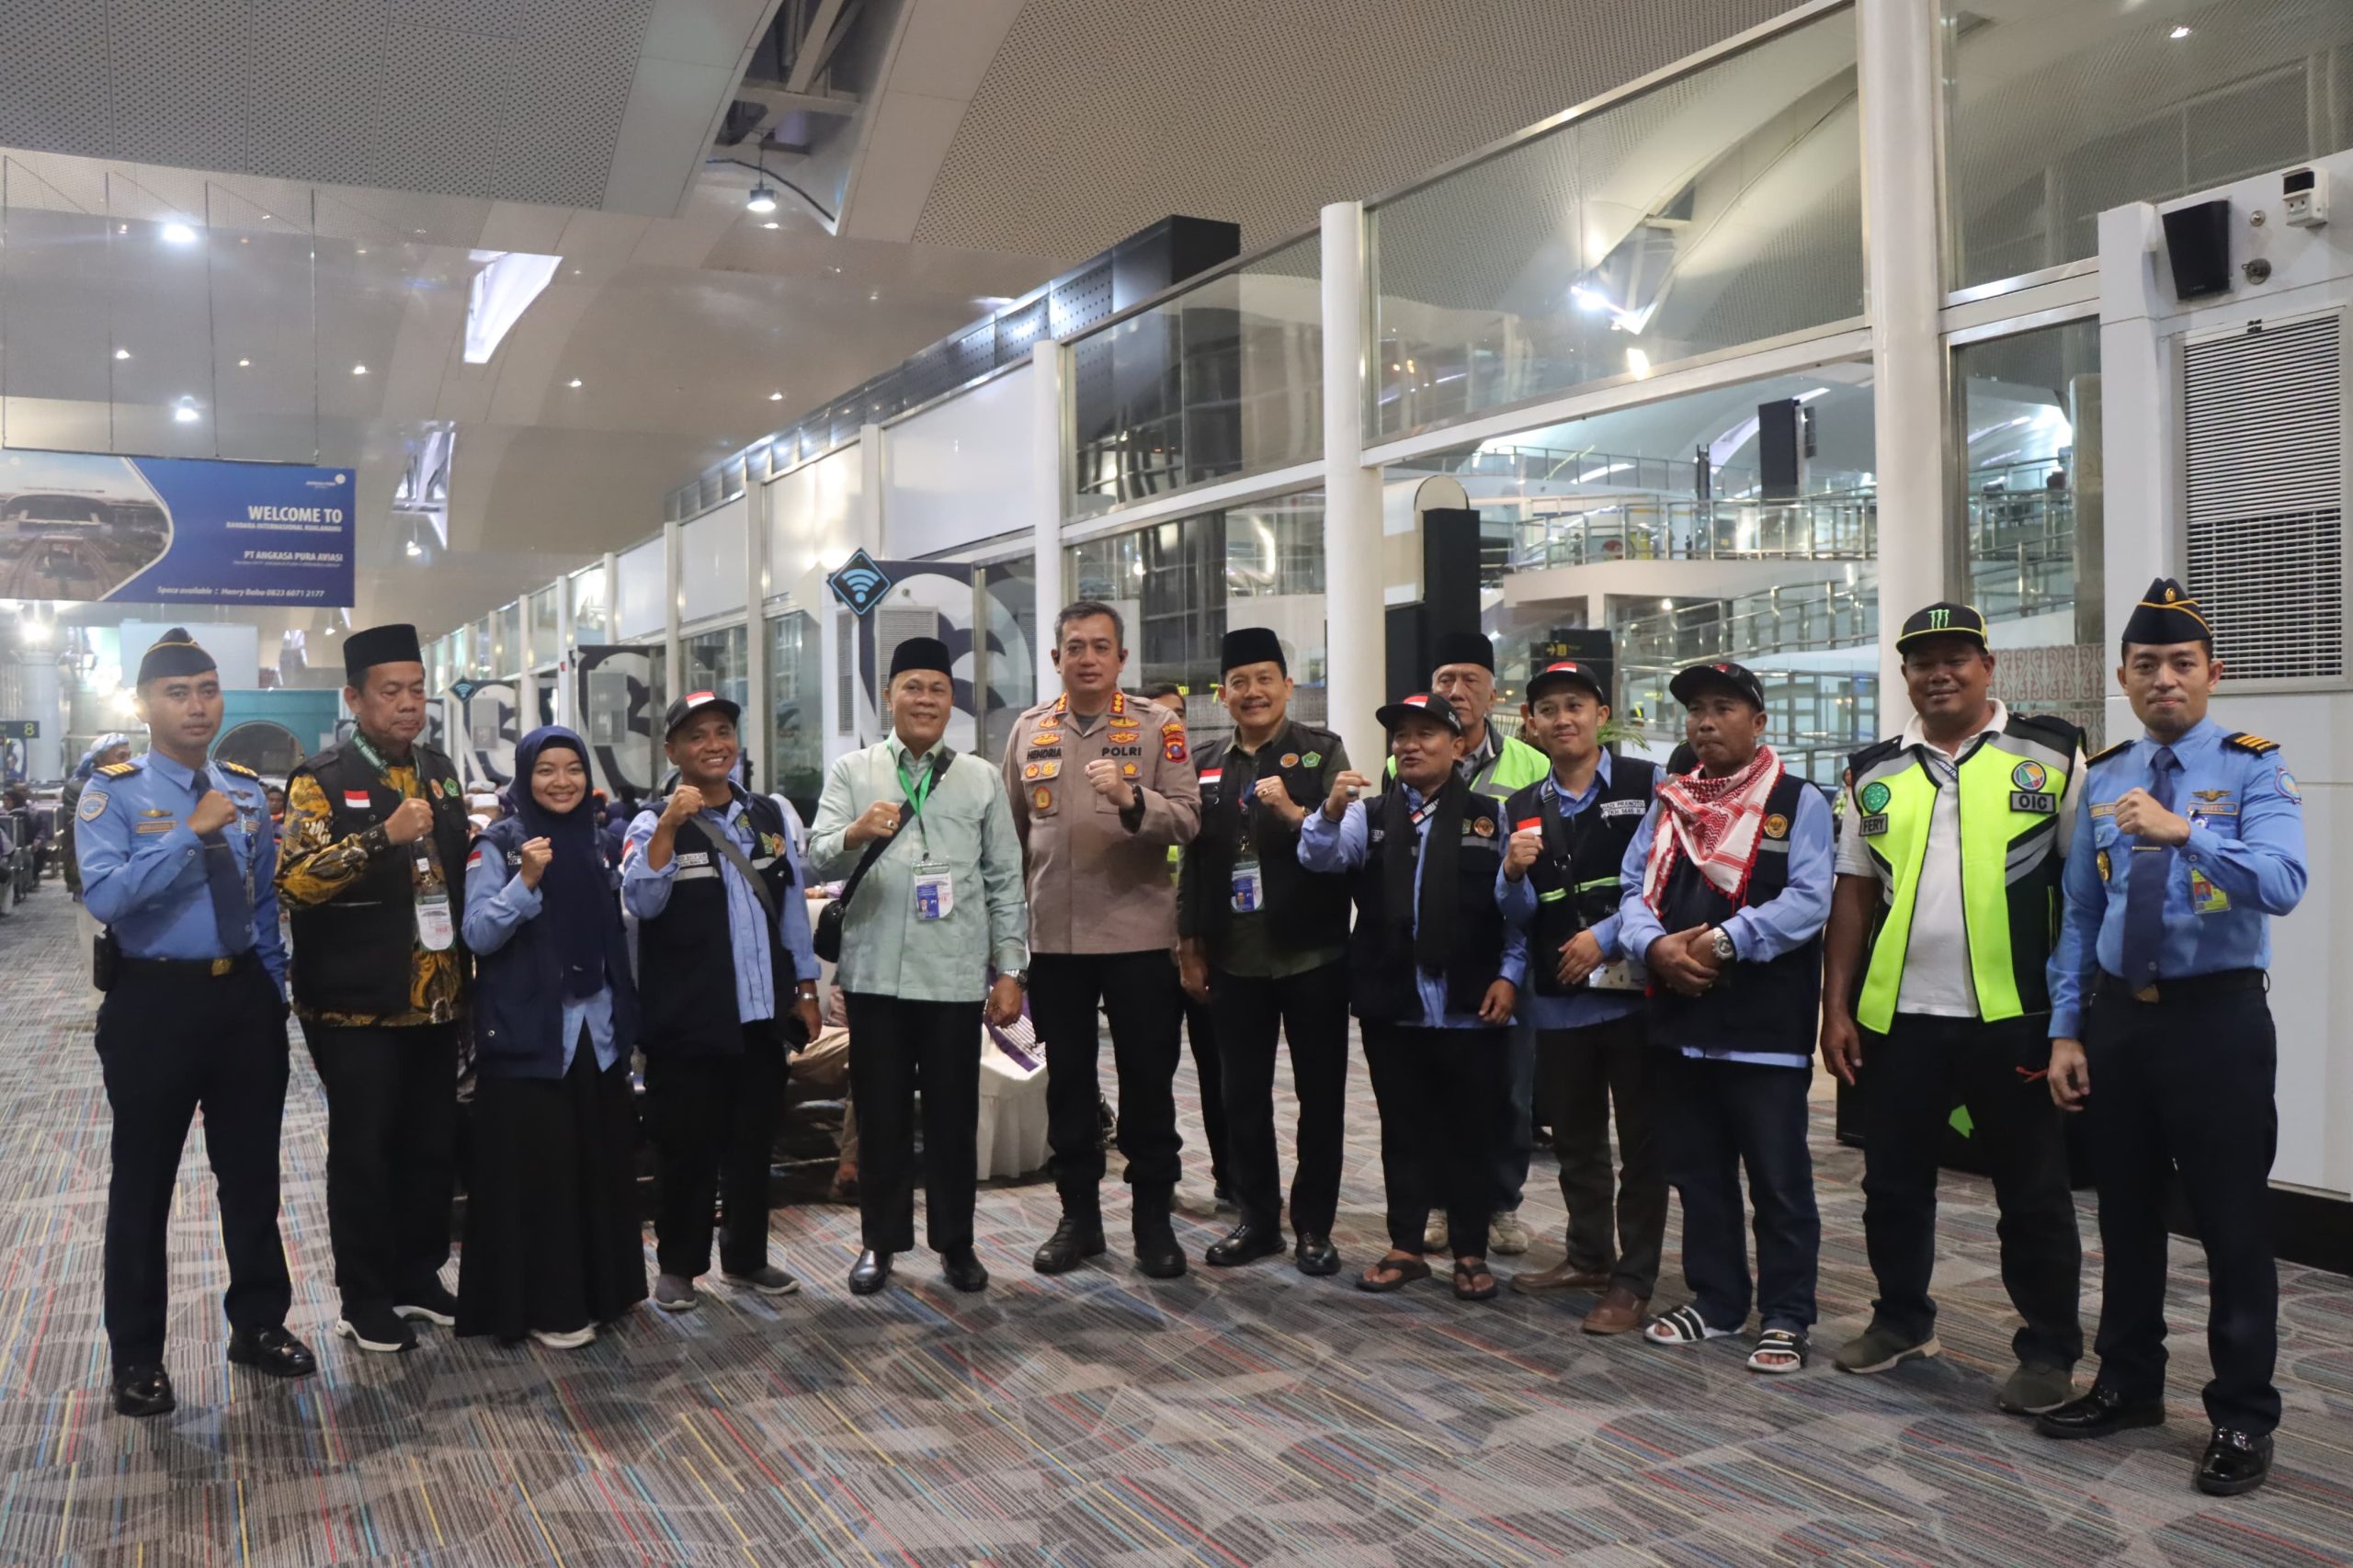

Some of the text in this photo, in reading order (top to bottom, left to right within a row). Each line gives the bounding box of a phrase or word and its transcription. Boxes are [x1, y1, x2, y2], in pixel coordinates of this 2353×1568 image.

[248, 506, 344, 523] WELCOME TO
[244, 551, 344, 562] PT ANGKASA PURA AVIASI
[157, 586, 179, 597] Space
[221, 588, 244, 597] Henry
[24, 722, 35, 736] 8
[1027, 747, 1063, 761] HENDRIA
[1101, 746, 1142, 757] POLRI
[2018, 794, 2047, 810] OIC
[1863, 817, 1884, 833] FERY
